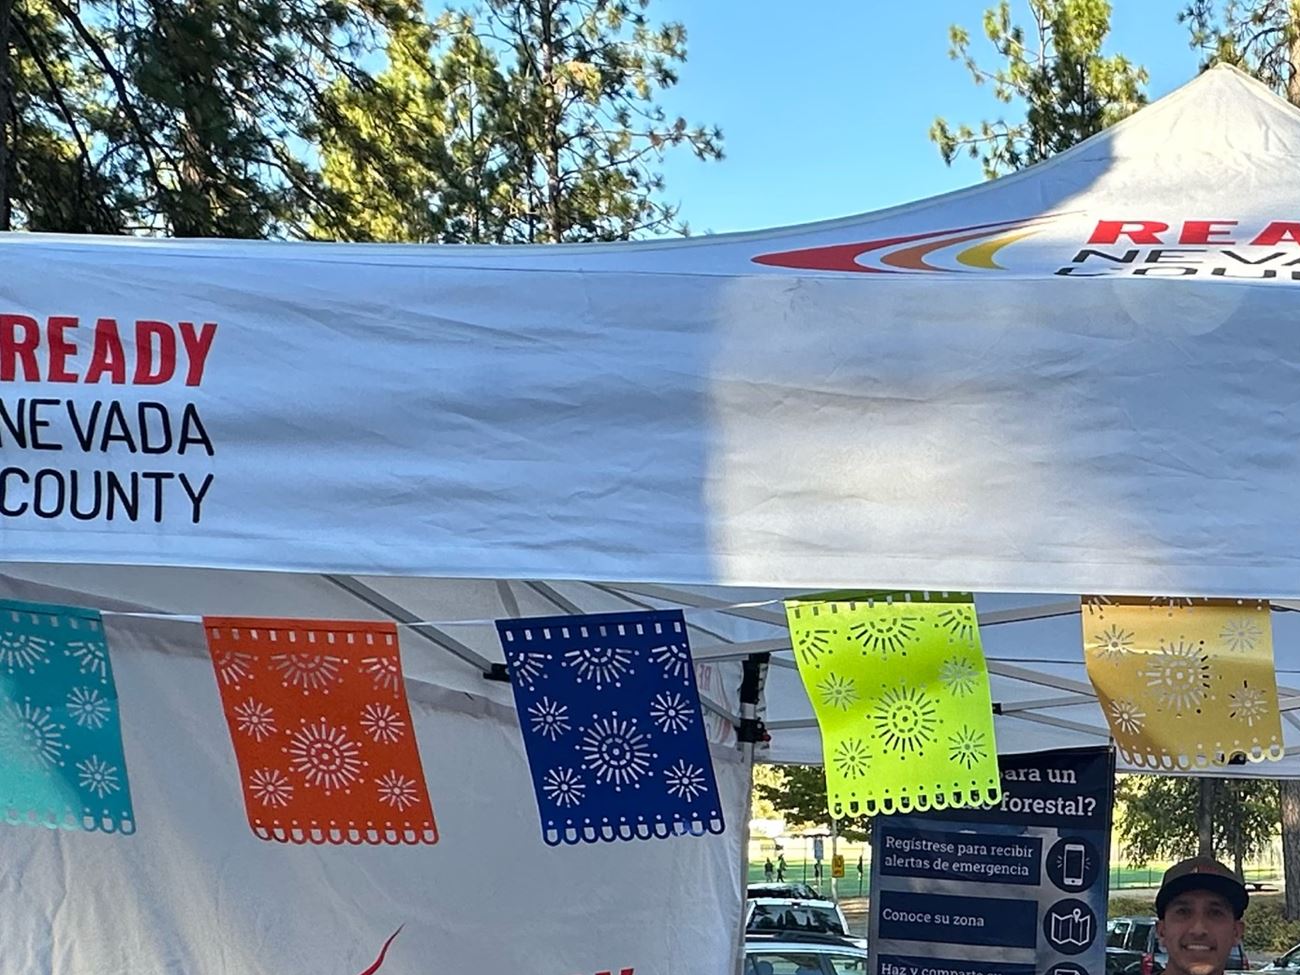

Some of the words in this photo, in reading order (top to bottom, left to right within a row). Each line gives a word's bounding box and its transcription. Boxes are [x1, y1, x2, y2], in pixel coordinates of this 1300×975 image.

[0, 314, 218, 387] READY
[0, 398, 215, 456] NEVADA
[0, 467, 214, 523] COUNTY
[1047, 768, 1076, 784] un
[1000, 792, 1096, 816] forestal?
[885, 836, 954, 854] Regístrese
[958, 844, 987, 857] para
[990, 843, 1033, 858] recibir
[884, 855, 930, 869] alertas
[932, 857, 949, 871] de
[952, 861, 1029, 877] emergencia
[882, 908, 931, 923] Conoce
[934, 915, 950, 924] su
[953, 916, 984, 926] zona
[881, 963, 907, 975] Haz
